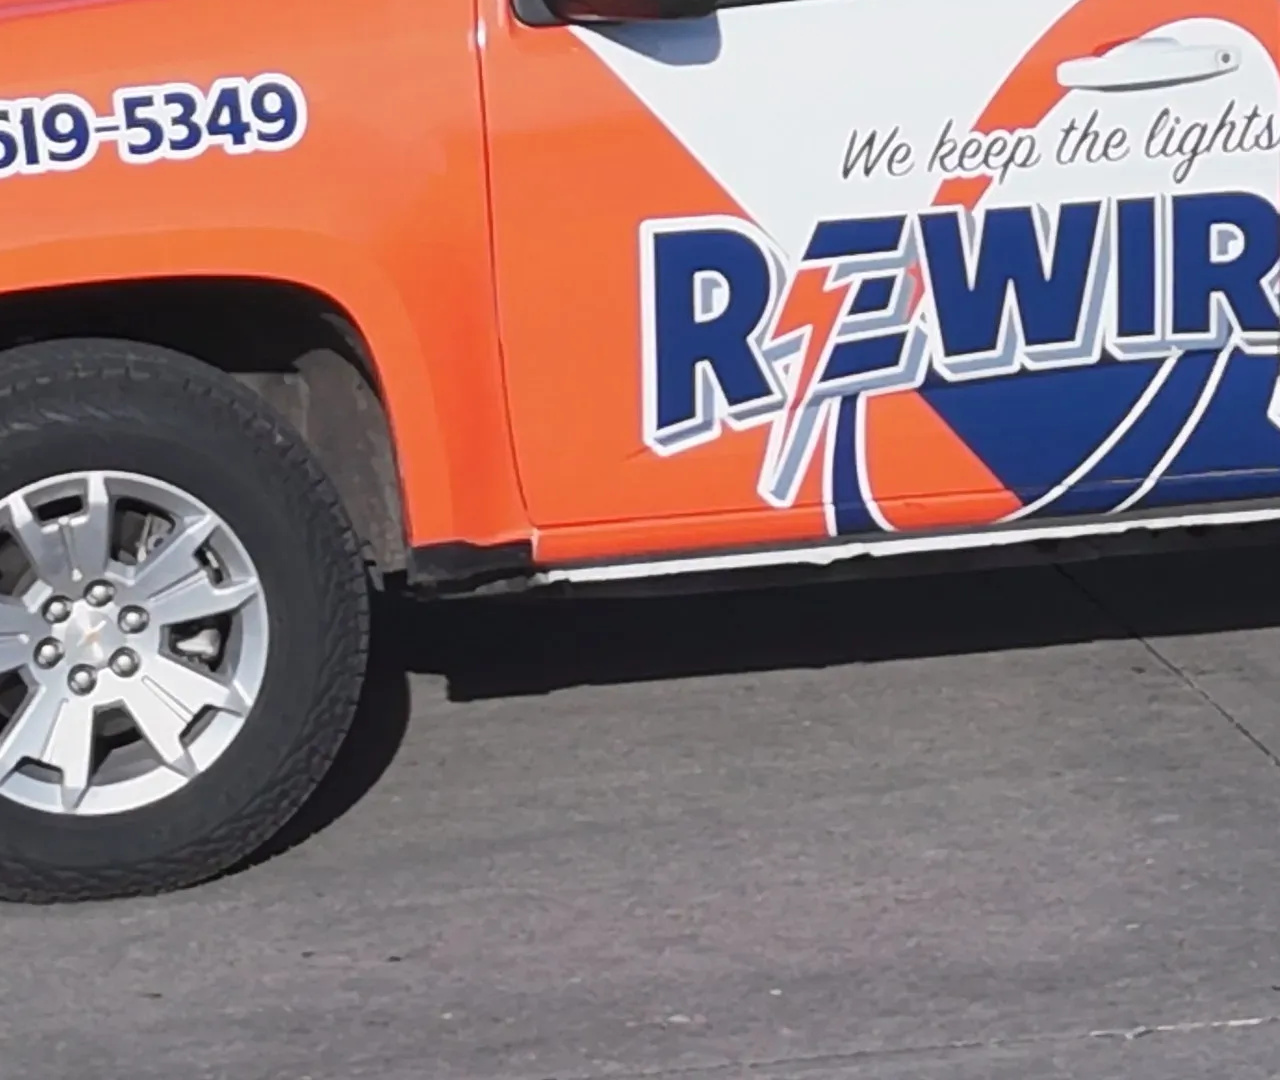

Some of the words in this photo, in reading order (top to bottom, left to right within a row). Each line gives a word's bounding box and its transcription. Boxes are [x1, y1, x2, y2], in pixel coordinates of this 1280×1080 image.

[842, 125, 916, 180] We
[927, 118, 1041, 186] keep
[1055, 108, 1131, 166] the
